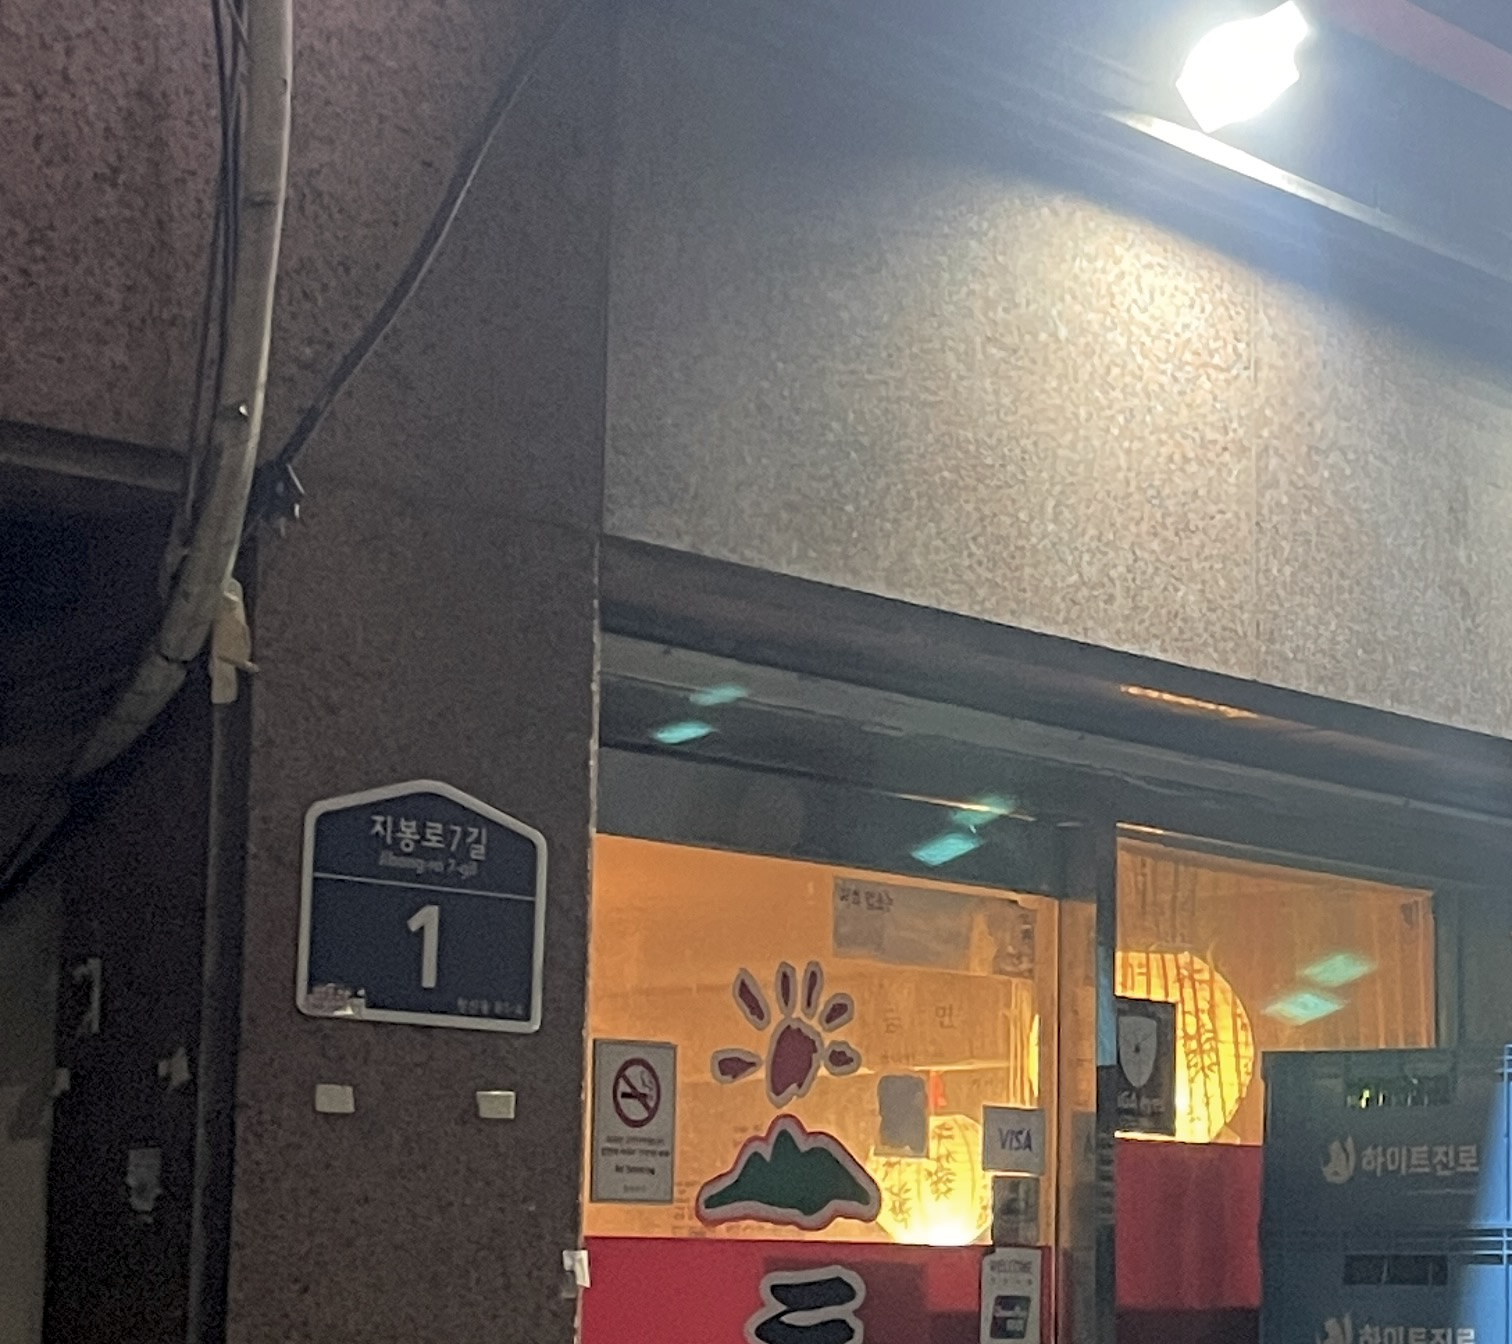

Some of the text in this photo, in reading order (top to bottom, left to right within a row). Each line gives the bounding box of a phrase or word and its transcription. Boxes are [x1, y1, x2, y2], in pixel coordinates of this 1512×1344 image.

[370, 815, 487, 861] 지봉로7길
[406, 904, 440, 989] 1
[998, 1127, 1034, 1153] VISA
[1361, 1144, 1480, 1178] 하이트진로
